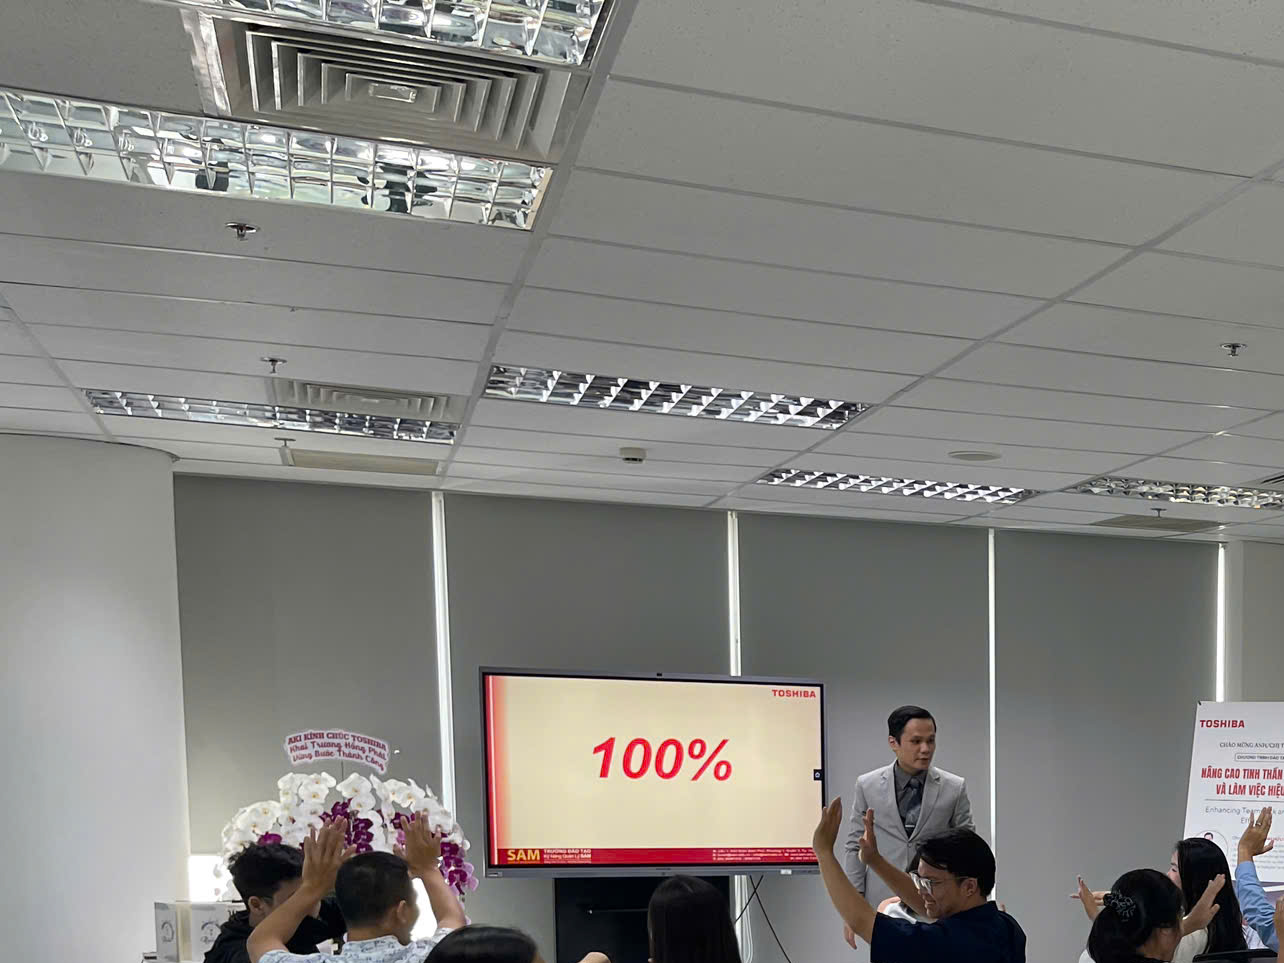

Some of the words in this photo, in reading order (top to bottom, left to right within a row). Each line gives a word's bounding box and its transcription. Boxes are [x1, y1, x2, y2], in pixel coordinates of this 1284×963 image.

[772, 689, 816, 698] TOSHIBA
[1200, 720, 1245, 728] TOSHIBA
[351, 735, 387, 751] TOSHIBA
[592, 737, 732, 781] 100%
[1201, 765, 1222, 779] NÂNG
[1224, 768, 1240, 779] CAO
[1243, 768, 1260, 779] TINH
[1216, 782, 1226, 795] VÀ
[1229, 782, 1246, 795] LÀM
[1249, 783, 1266, 798] VIỆC
[1205, 806, 1240, 815] Enhancing
[507, 849, 540, 860] SAM
